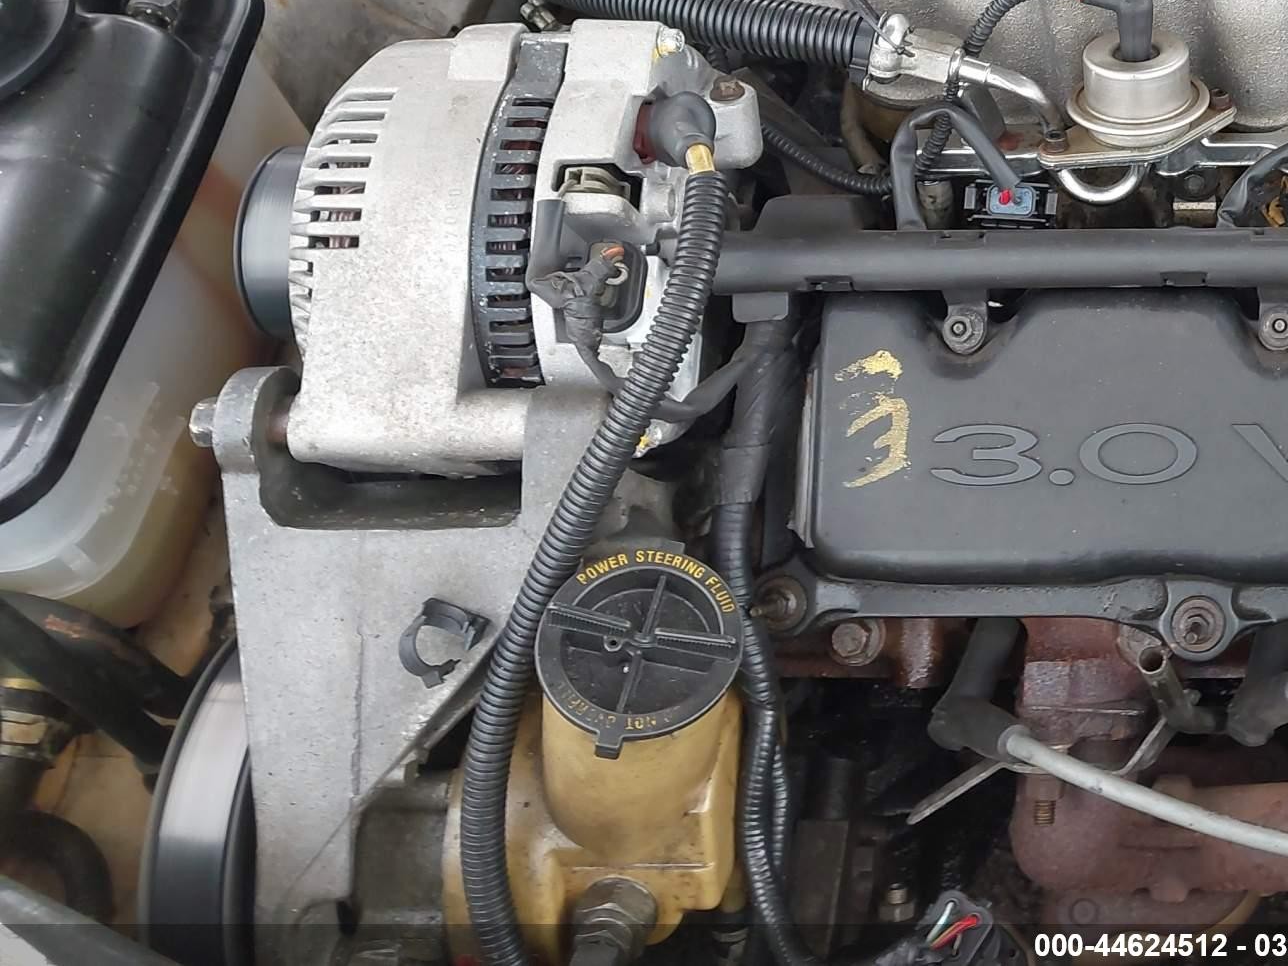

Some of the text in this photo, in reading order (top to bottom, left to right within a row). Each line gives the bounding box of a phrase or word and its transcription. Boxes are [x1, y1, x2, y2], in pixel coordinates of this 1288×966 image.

[930, 423, 1198, 486] 3.0
[576, 550, 735, 614] POWER STEERING FLUID
